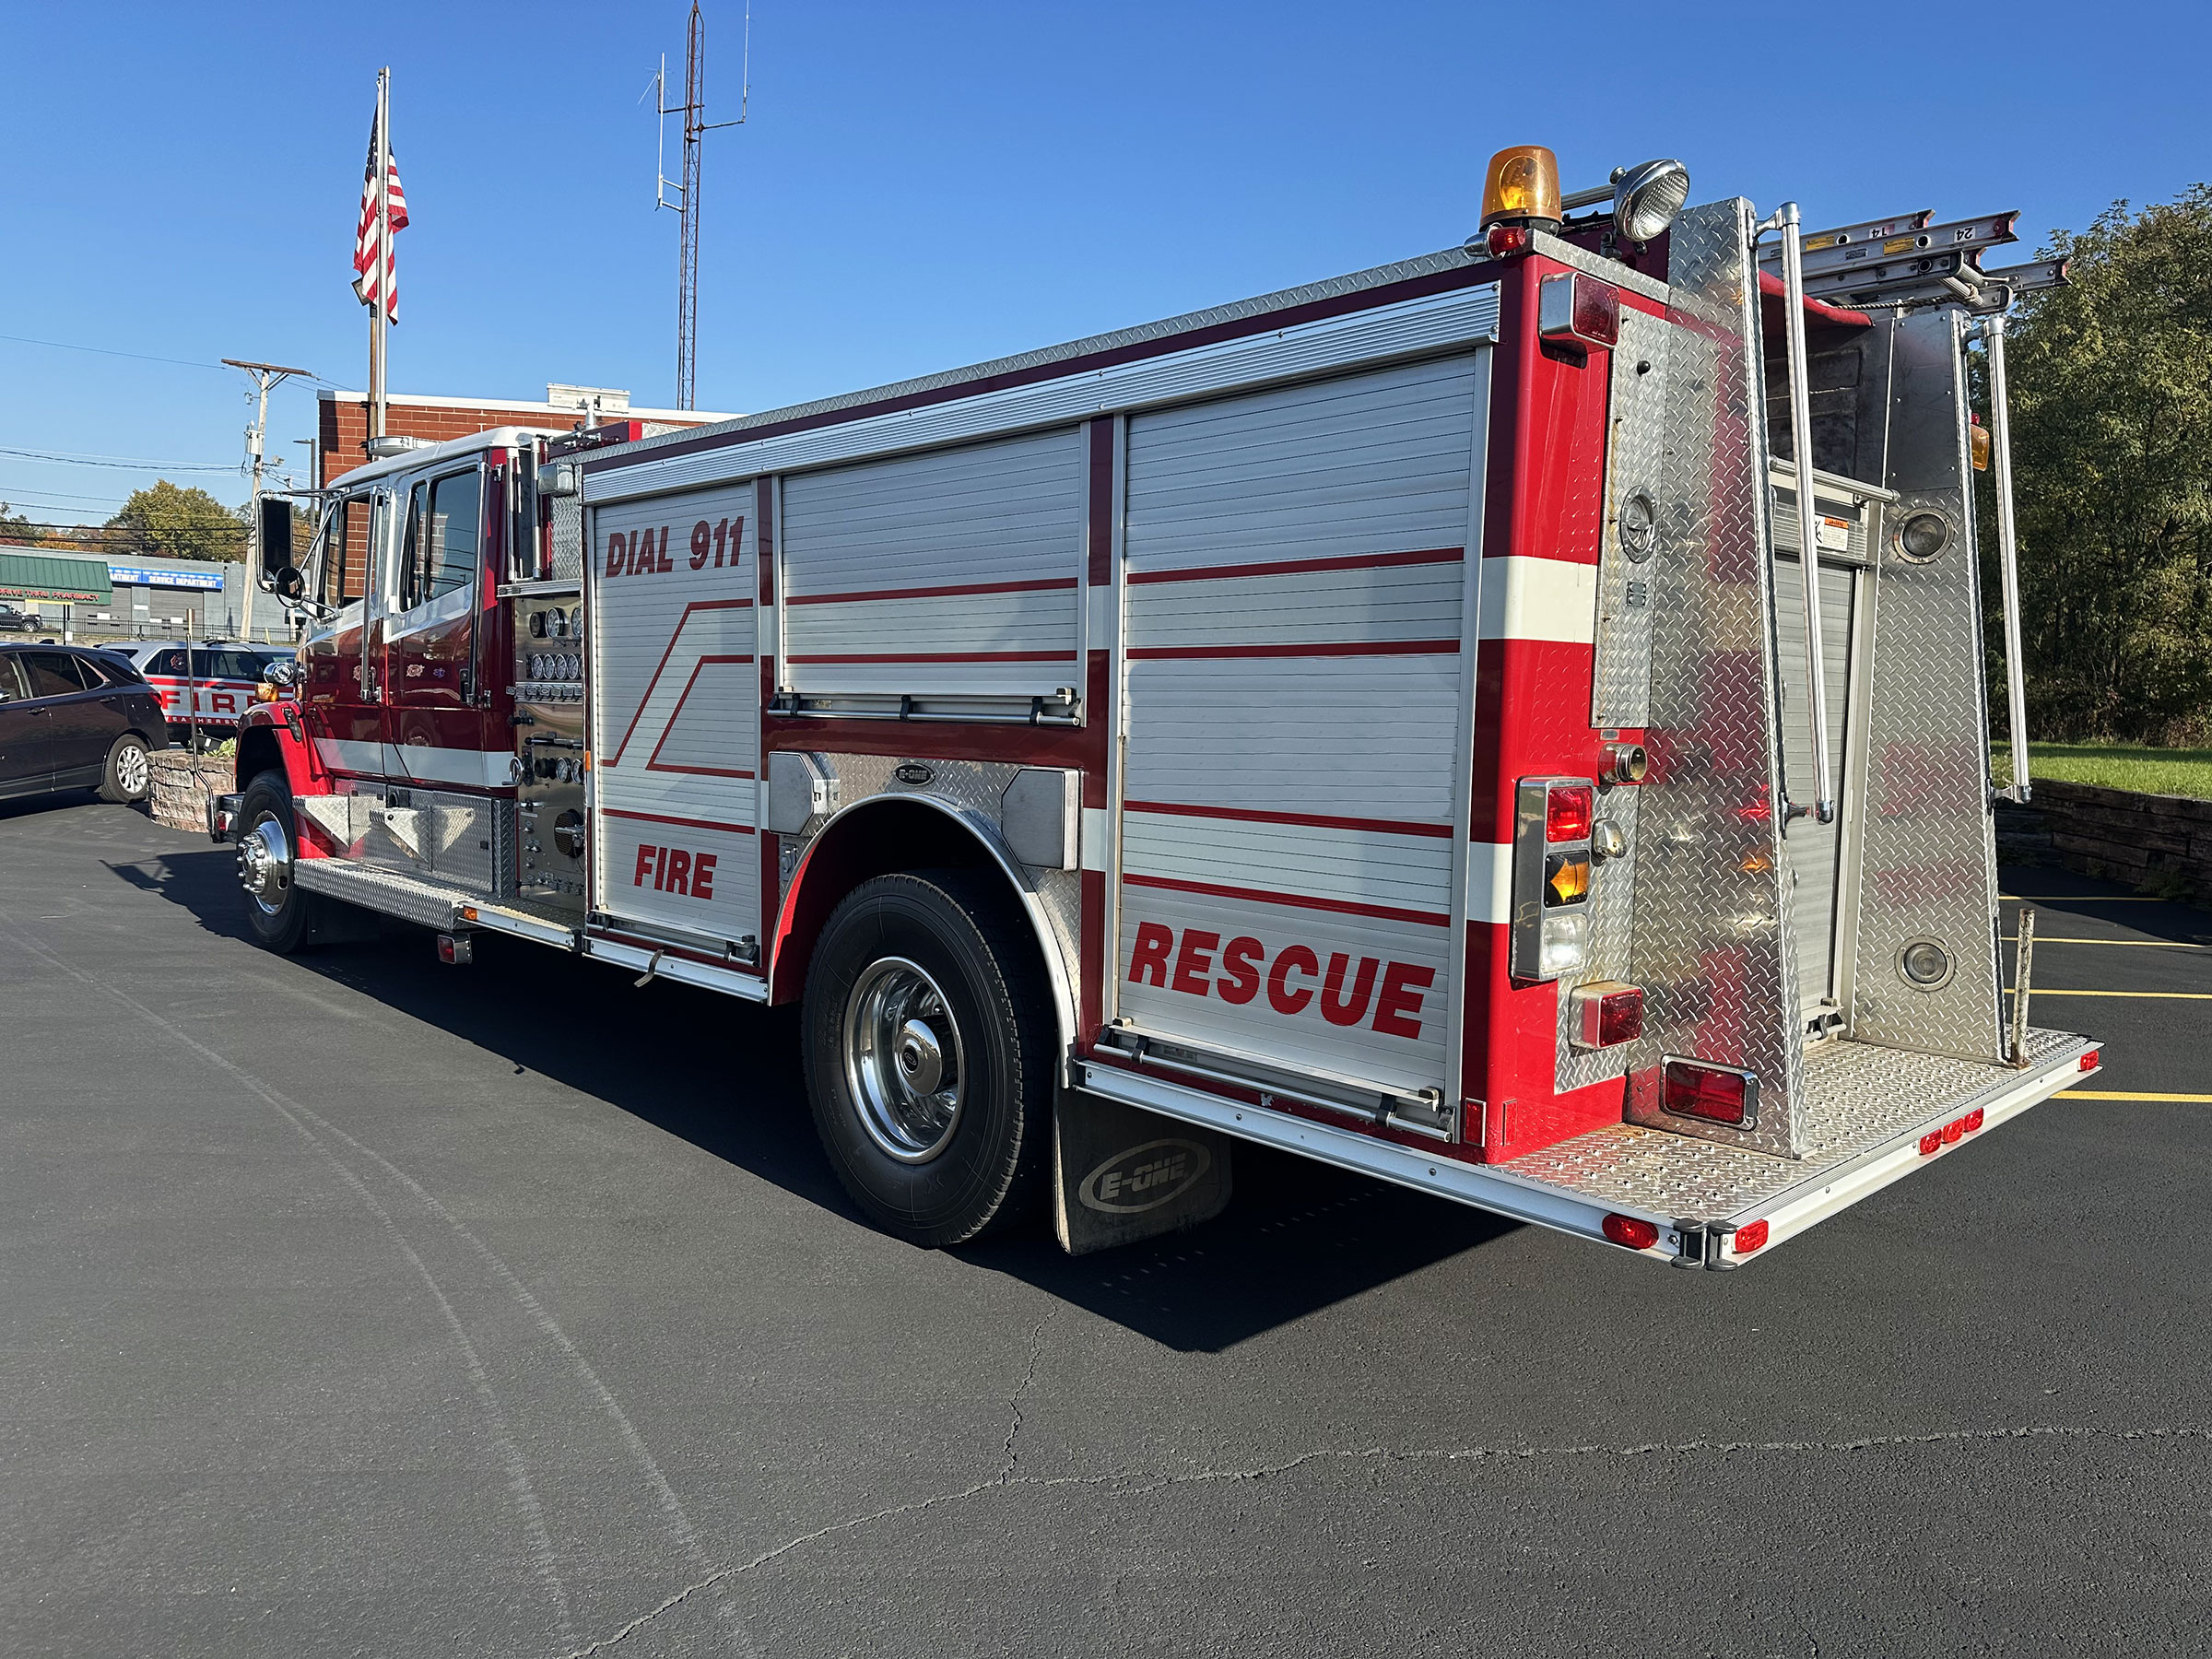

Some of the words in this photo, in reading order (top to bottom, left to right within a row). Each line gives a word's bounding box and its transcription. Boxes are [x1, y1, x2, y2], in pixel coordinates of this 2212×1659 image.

[1871, 227, 1888, 238] 14
[1956, 227, 1973, 241] 24
[606, 526, 673, 578] DIAL
[689, 516, 745, 571] 911
[25, 590, 49, 599] THRU
[52, 591, 100, 602] PHARMACY
[148, 575, 174, 584] SERVICE
[175, 578, 218, 587] DEPARTMENT
[634, 844, 717, 900] FIRE
[1128, 922, 1436, 1040] RESCUE
[1100, 1152, 1187, 1201] E-ONE
